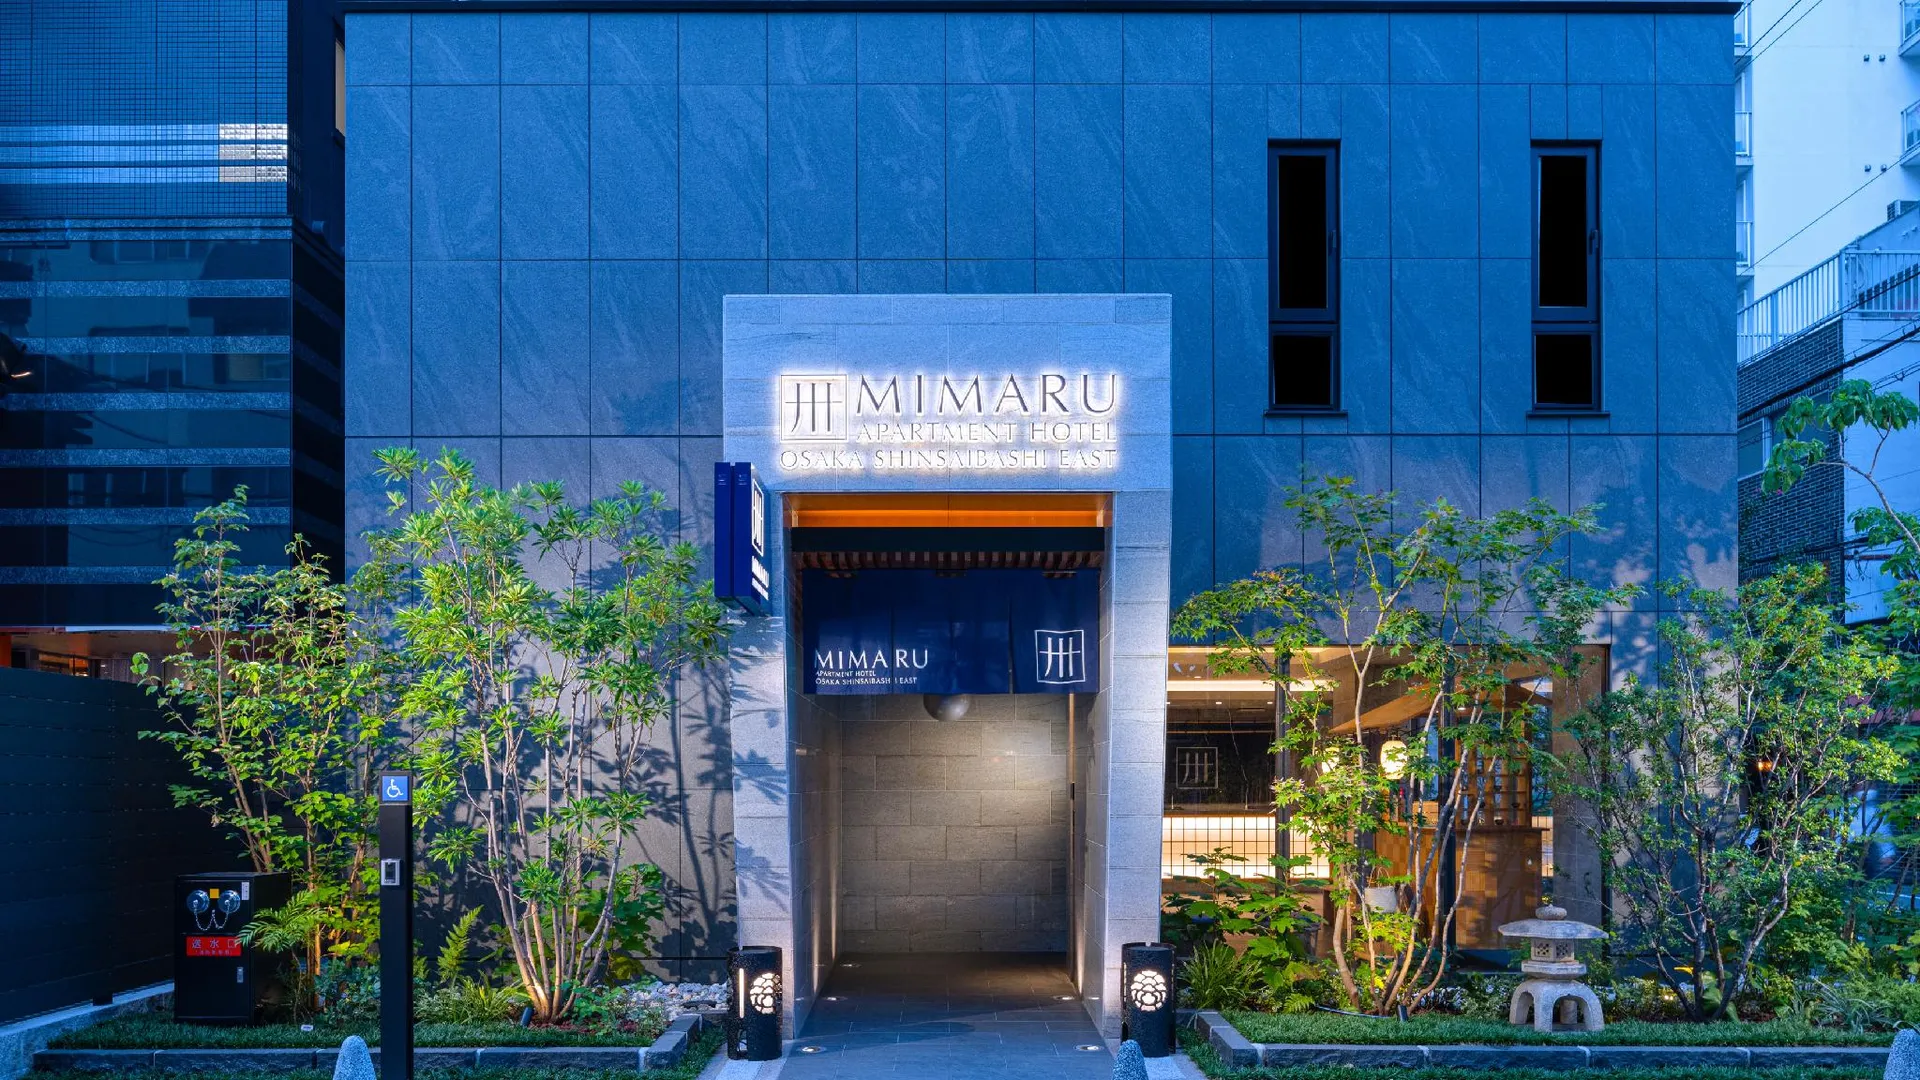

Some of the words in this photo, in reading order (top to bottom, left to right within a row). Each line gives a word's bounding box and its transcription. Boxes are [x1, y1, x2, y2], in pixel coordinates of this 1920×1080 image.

[856, 374, 1117, 414] MIMARU
[856, 422, 1017, 441] APARTMENT
[1030, 422, 1117, 441] HOTEL
[780, 450, 864, 468] OSAKA
[874, 450, 1047, 468] SHINSAIBASHI
[1059, 450, 1117, 468] EAST
[814, 649, 928, 669] MIMARU
[899, 677, 918, 685] EAST
